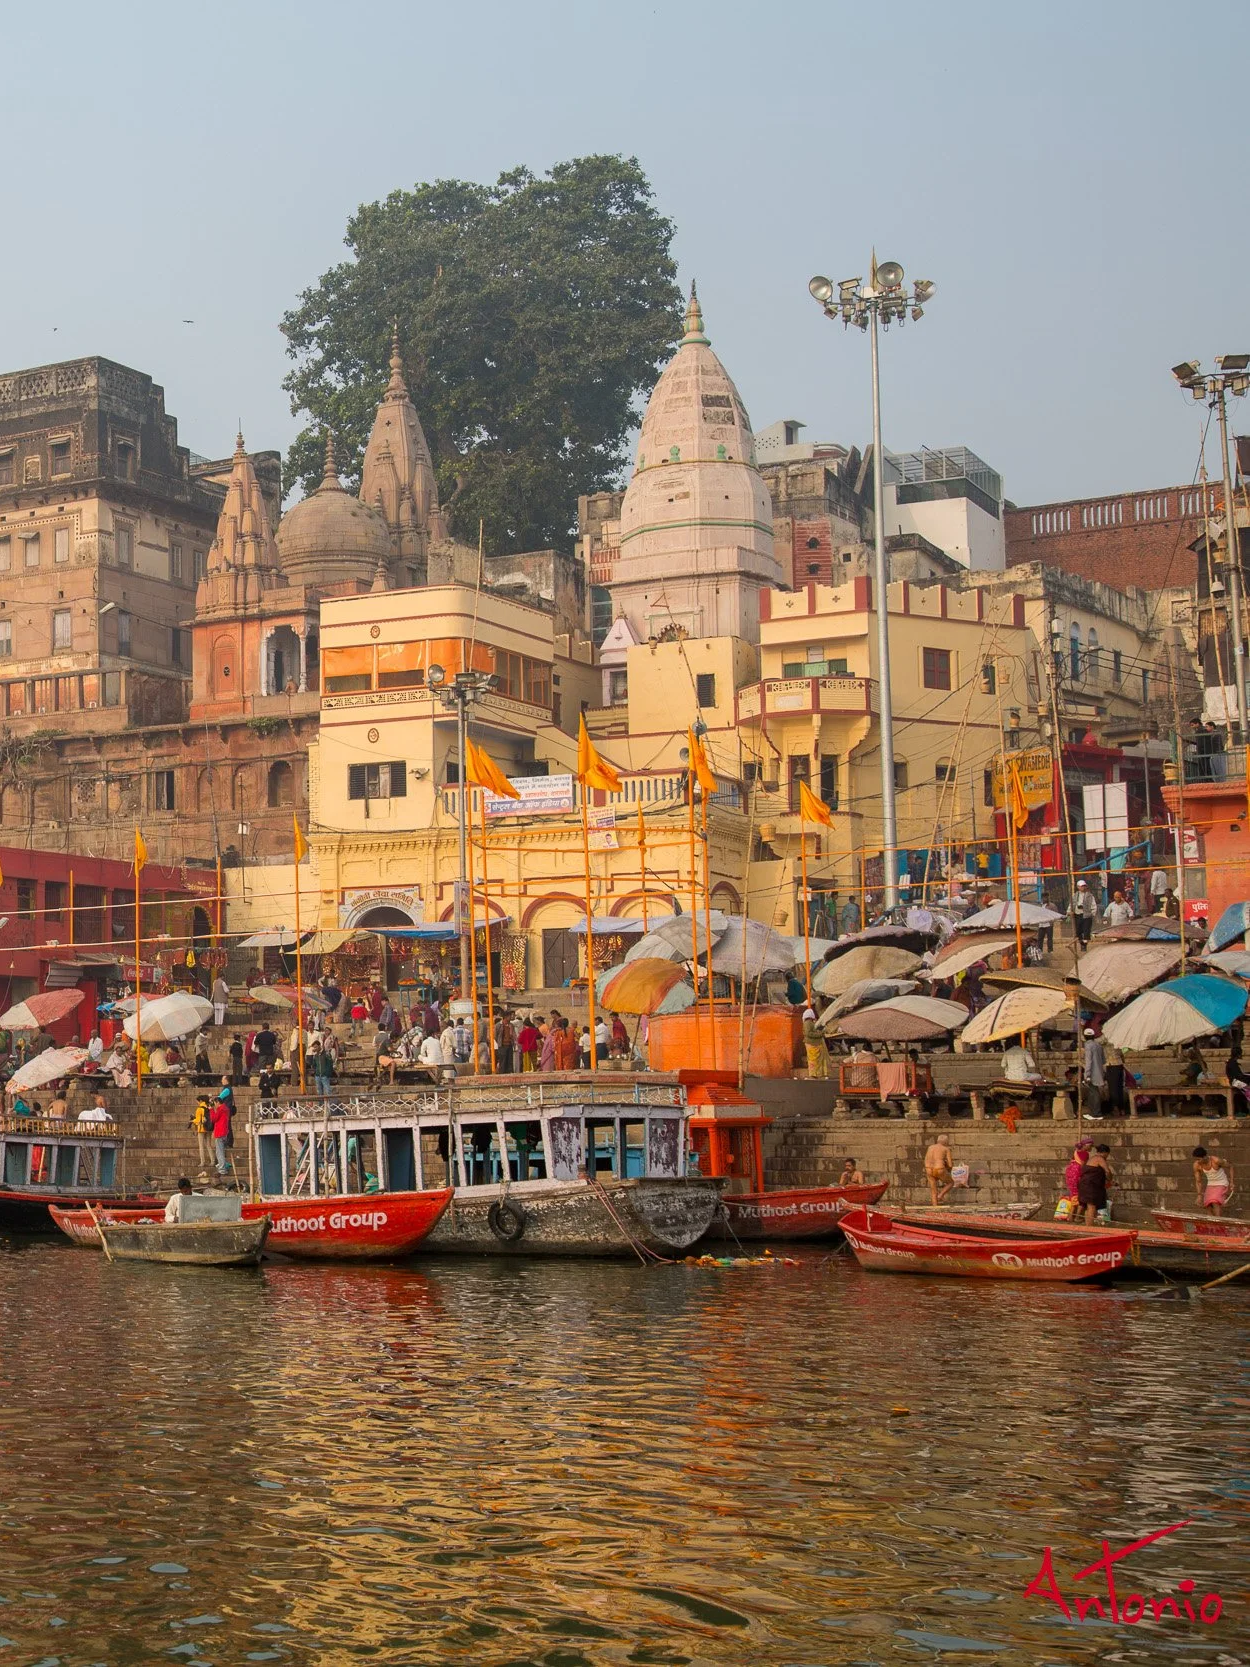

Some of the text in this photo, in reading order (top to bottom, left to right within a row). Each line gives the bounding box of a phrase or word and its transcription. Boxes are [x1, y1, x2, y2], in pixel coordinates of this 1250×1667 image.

[738, 1203, 799, 1219] Muthoot
[269, 1211, 388, 1233] uthoot Group
[858, 1240, 916, 1261] Muthoot Group
[1026, 1254, 1075, 1268] Muthoot
[1077, 1251, 1122, 1268] Group
